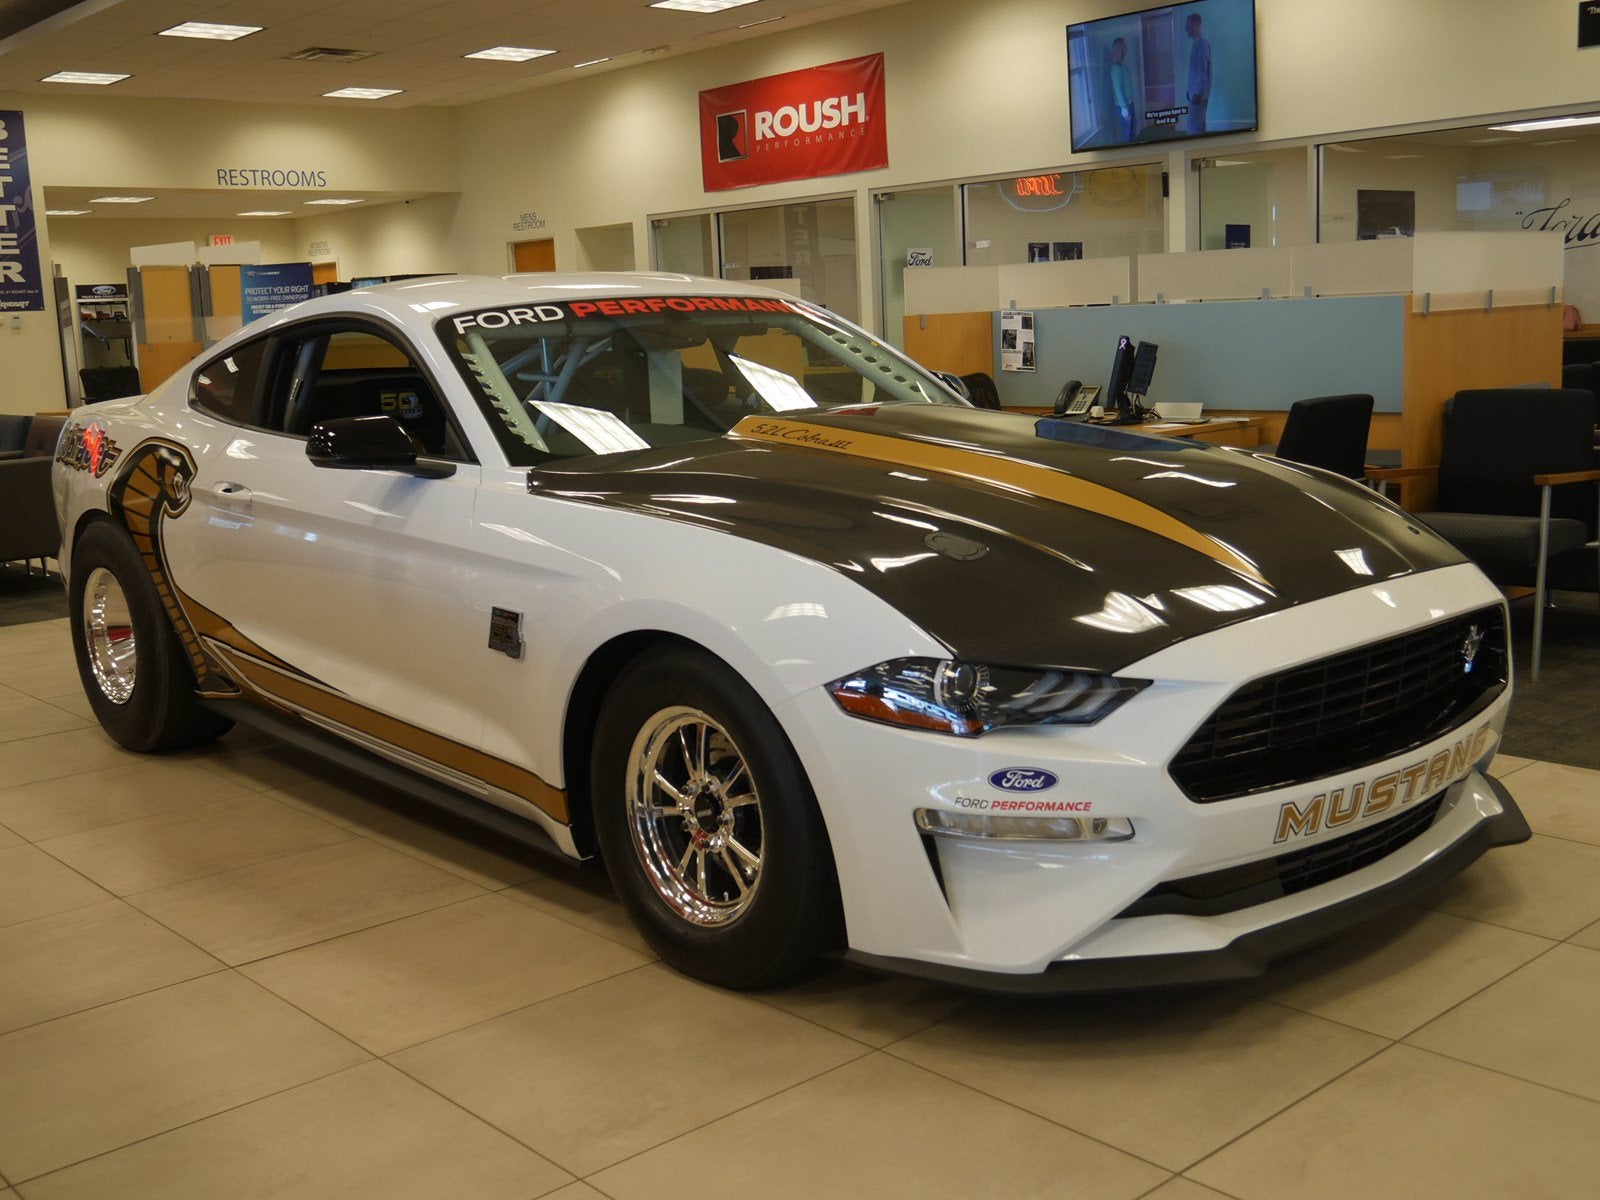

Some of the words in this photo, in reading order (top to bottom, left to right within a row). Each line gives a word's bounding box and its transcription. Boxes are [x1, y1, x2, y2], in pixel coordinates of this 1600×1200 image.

[754, 92, 866, 141] ROUSH
[756, 127, 866, 152] PERFORMANCE
[217, 169, 327, 187] RESTROOMS
[513, 219, 545, 231] RESTROOM
[908, 251, 933, 266] Ford
[245, 286, 272, 295] PROTECT
[273, 285, 290, 294] YOUR
[290, 284, 309, 293] RIGHT
[453, 305, 564, 335] FORD
[998, 769, 1049, 790] Ford
[1273, 721, 1491, 844] MUSTANG
[954, 796, 988, 810] FORD
[990, 800, 1092, 812] PERFORMANCE
